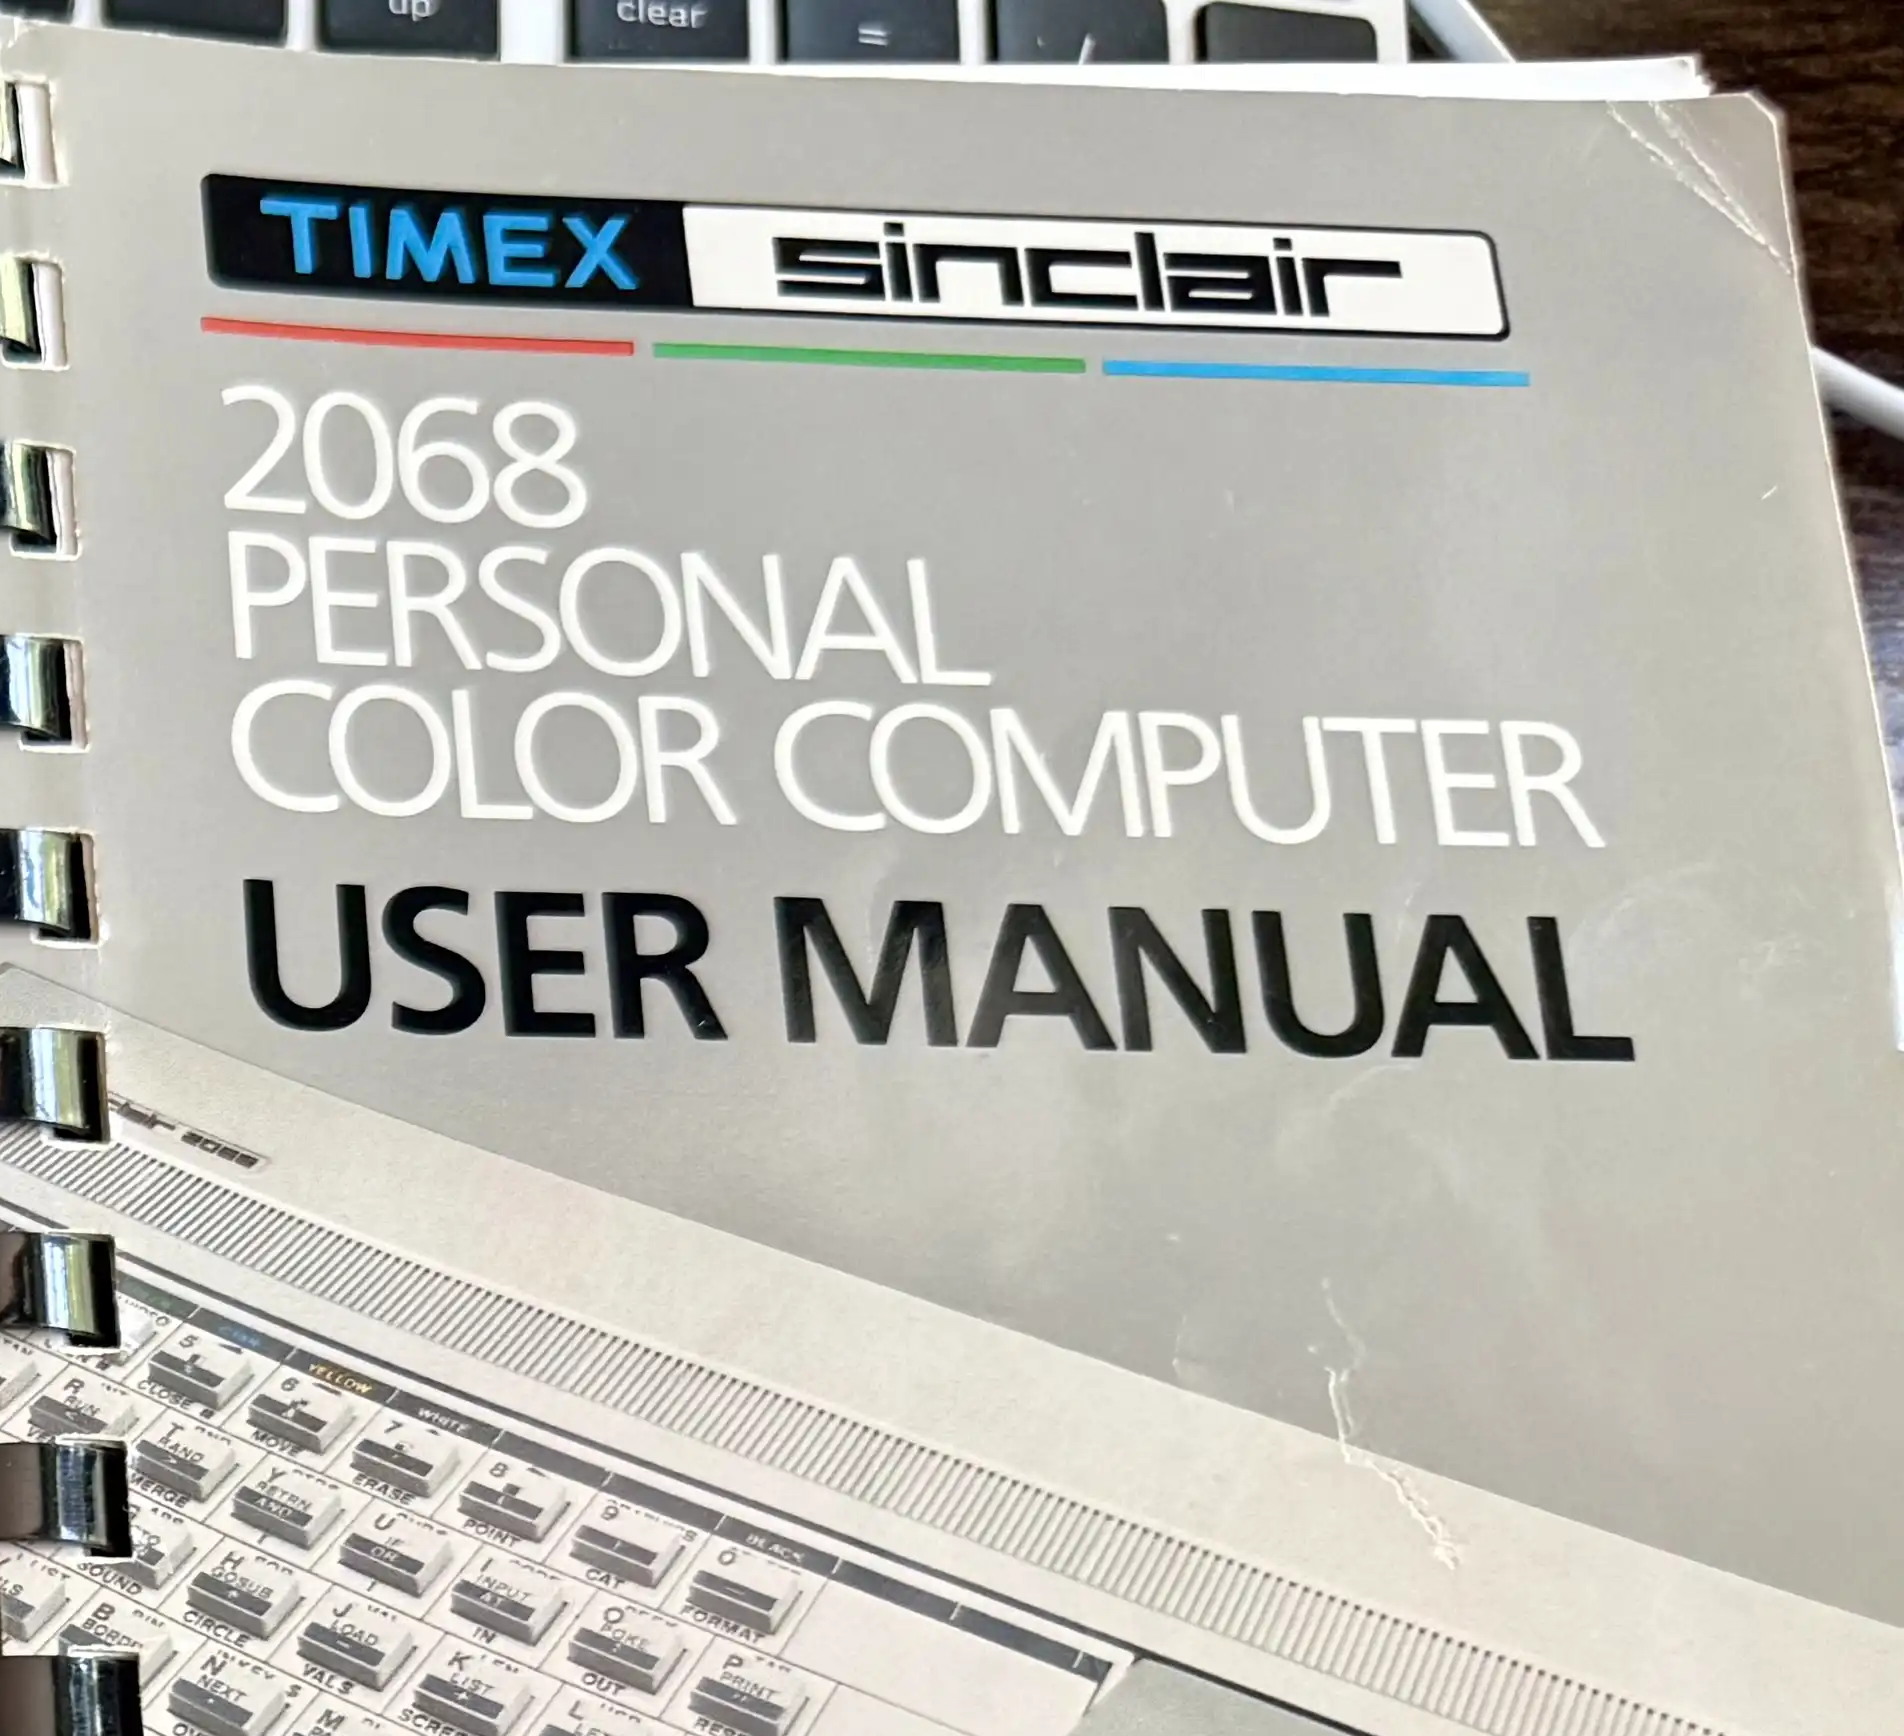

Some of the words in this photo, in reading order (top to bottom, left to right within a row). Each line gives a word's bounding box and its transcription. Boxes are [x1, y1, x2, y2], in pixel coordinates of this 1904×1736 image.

[260, 199, 635, 289] TIMEX
[774, 223, 1401, 316] sinclair
[222, 384, 587, 527] 2068
[229, 531, 991, 685] PERSONAL
[232, 679, 736, 824] COLOR
[775, 701, 1605, 847] COMPUTER
[243, 881, 728, 1040] USER
[774, 897, 1635, 1061] MANUAL
[308, 1362, 373, 1394] YELLOW
[252, 1429, 303, 1454] MOVE
[353, 1474, 416, 1506] ERASE
[464, 1520, 522, 1548] POINT
[586, 1569, 626, 1592] CAT
[183, 1610, 251, 1648] CIRCLE
[681, 1605, 766, 1645] FORMAT
[199, 1675, 246, 1702] NEXT
[582, 1672, 627, 1696] OUT
